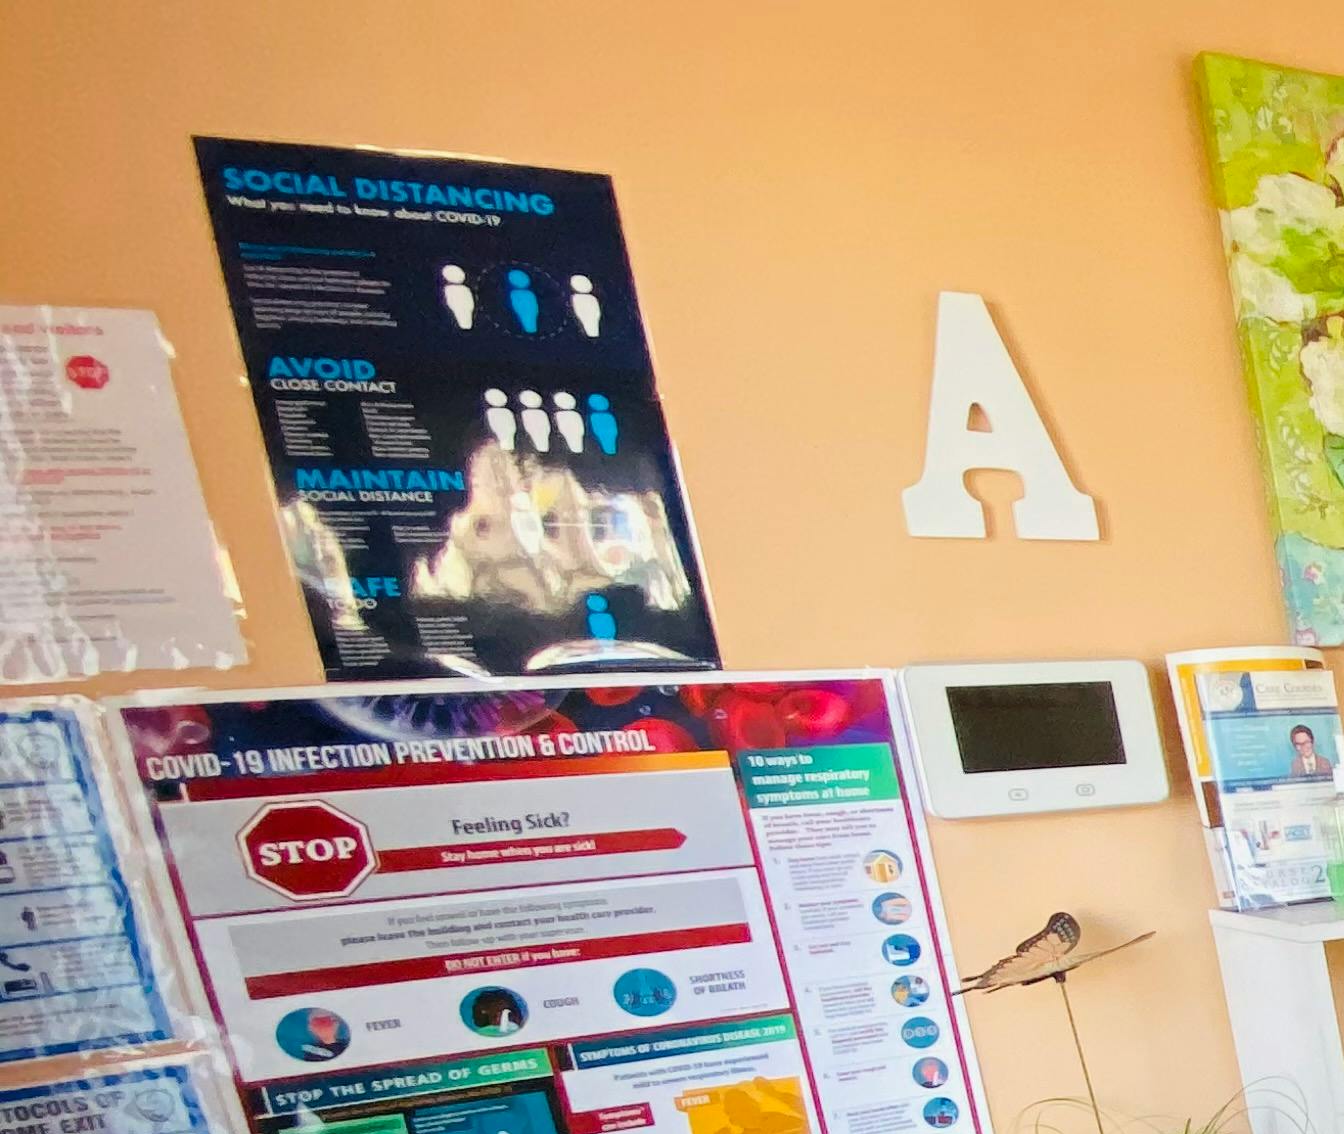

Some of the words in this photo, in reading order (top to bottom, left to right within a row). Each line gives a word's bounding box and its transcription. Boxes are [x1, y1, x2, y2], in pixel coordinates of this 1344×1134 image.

[223, 167, 347, 198] SOCIAL
[355, 177, 555, 216] DISTANCING
[227, 195, 265, 209] What
[394, 208, 432, 220] about
[435, 211, 501, 227] COVID-19
[269, 357, 375, 379] AVOID
[270, 378, 320, 392] CLOSE
[324, 380, 397, 394] CONTACT
[901, 291, 1100, 540] A
[296, 468, 465, 490] MAINTAIN
[360, 491, 433, 503] DISTANCE
[269, 740, 392, 771] INFECTION
[396, 735, 539, 764] PREVENTION
[542, 735, 555, 756] &
[558, 729, 656, 755] CONTROL
[748, 755, 764, 768] 10
[766, 756, 796, 769] ways
[799, 753, 813, 765] to
[752, 773, 803, 786] manage
[804, 769, 870, 784] respiratory
[756, 789, 819, 805] symptoms
[822, 788, 833, 798] at
[836, 786, 870, 797] home
[452, 817, 522, 835] Feeling
[525, 812, 570, 829] Sick?
[259, 837, 358, 866] STOP
[441, 851, 465, 863] Stay
[467, 848, 500, 860] home
[501, 846, 532, 857] when
[533, 845, 552, 857] you
[554, 843, 571, 853] are
[689, 970, 745, 985] SHORTNESS
[694, 985, 706, 995] OF
[708, 982, 745, 994] BREATH
[543, 997, 579, 1009] COUGH
[366, 1019, 401, 1032] FEVER
[580, 1045, 637, 1062] SYMPTOMS
[637, 1043, 650, 1054] OF
[652, 1035, 721, 1052] CORONAVIRUS
[275, 1089, 322, 1107] STOP
[330, 1084, 366, 1097] THE
[371, 1072, 442, 1092] SPREAD
[448, 1068, 470, 1080] OF
[478, 1059, 538, 1077] GERMS
[0, 1097, 89, 1124] TOCOLS
[680, 1094, 710, 1107] FEVER
